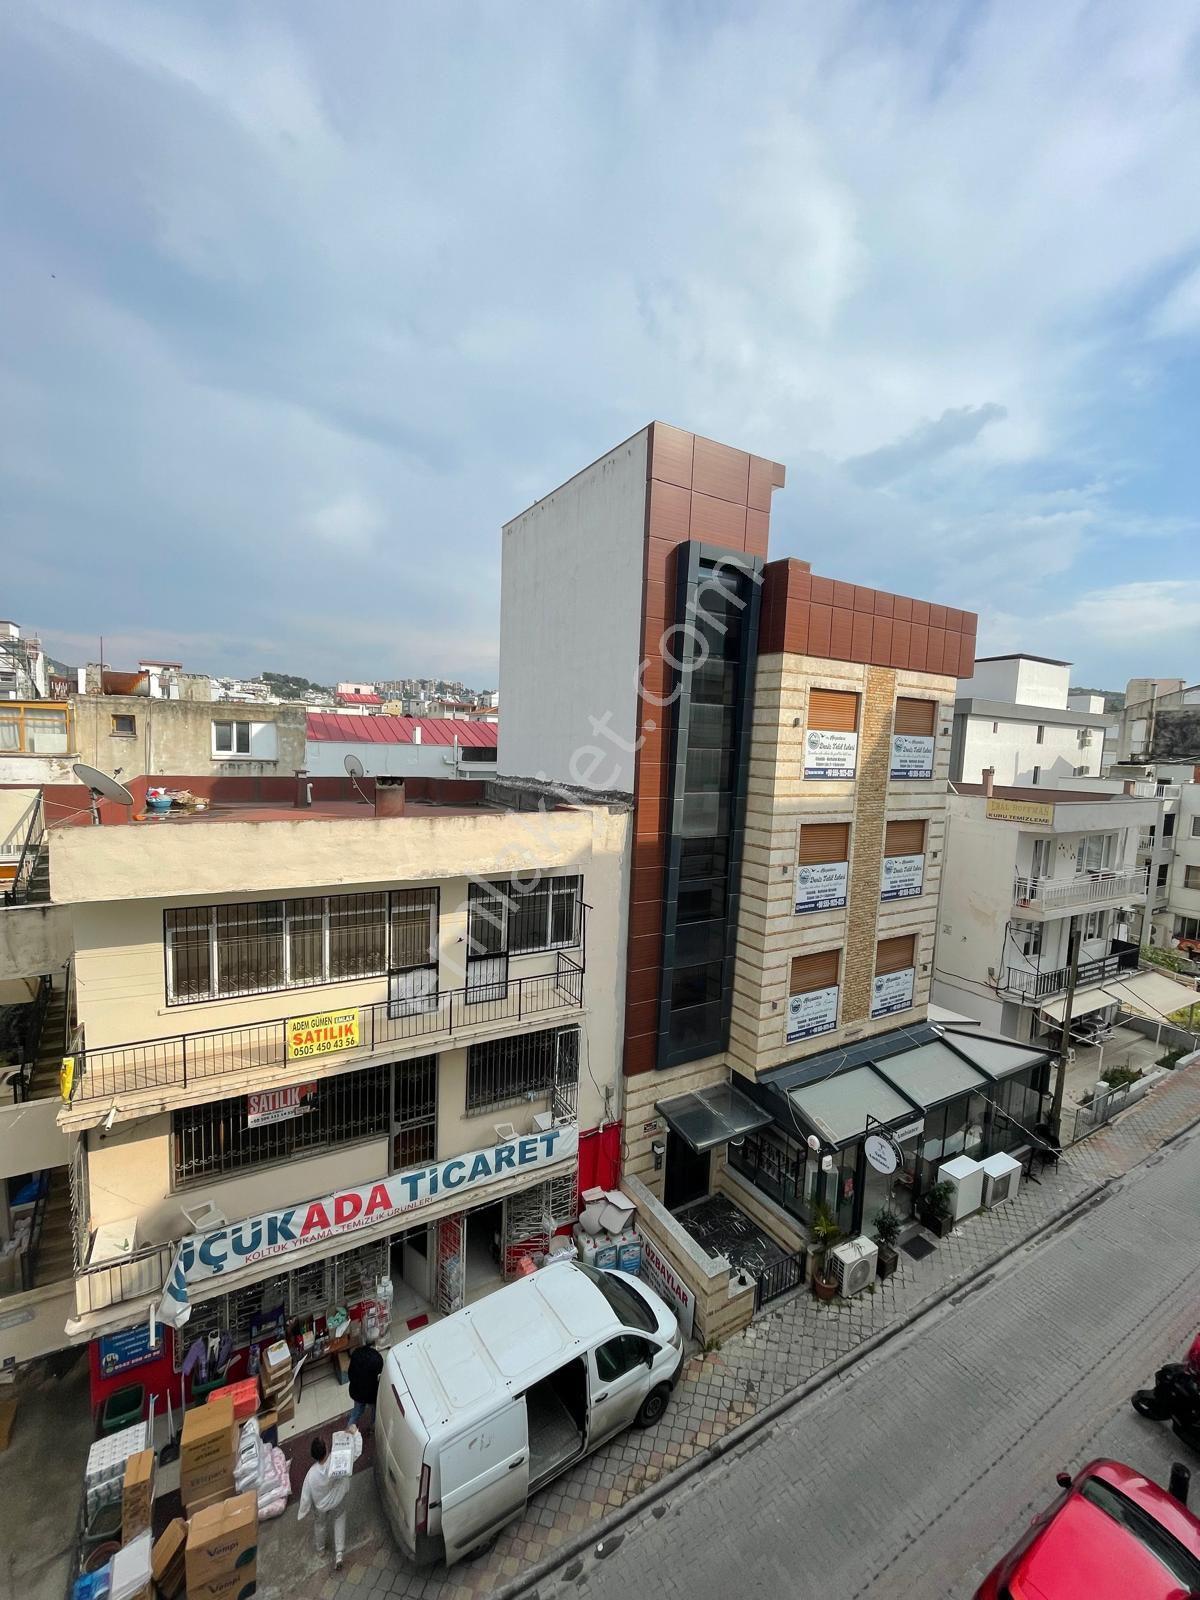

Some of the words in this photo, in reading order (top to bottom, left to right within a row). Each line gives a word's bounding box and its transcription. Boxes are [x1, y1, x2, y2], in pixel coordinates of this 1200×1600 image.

[292, 1021, 310, 1031] ADEM
[293, 1023, 354, 1046] SATILIK
[294, 1045, 314, 1056] 0505
[317, 1042, 331, 1051] 450
[334, 1040, 343, 1048] 43
[346, 1037, 354, 1046] 56
[250, 1087, 300, 1114] SATILIK
[401, 1131, 560, 1202] TİCARET
[245, 1243, 288, 1263] KOLTUK
[292, 1230, 333, 1247] YIKAMA
[342, 1212, 384, 1232] TEMİZLİK
